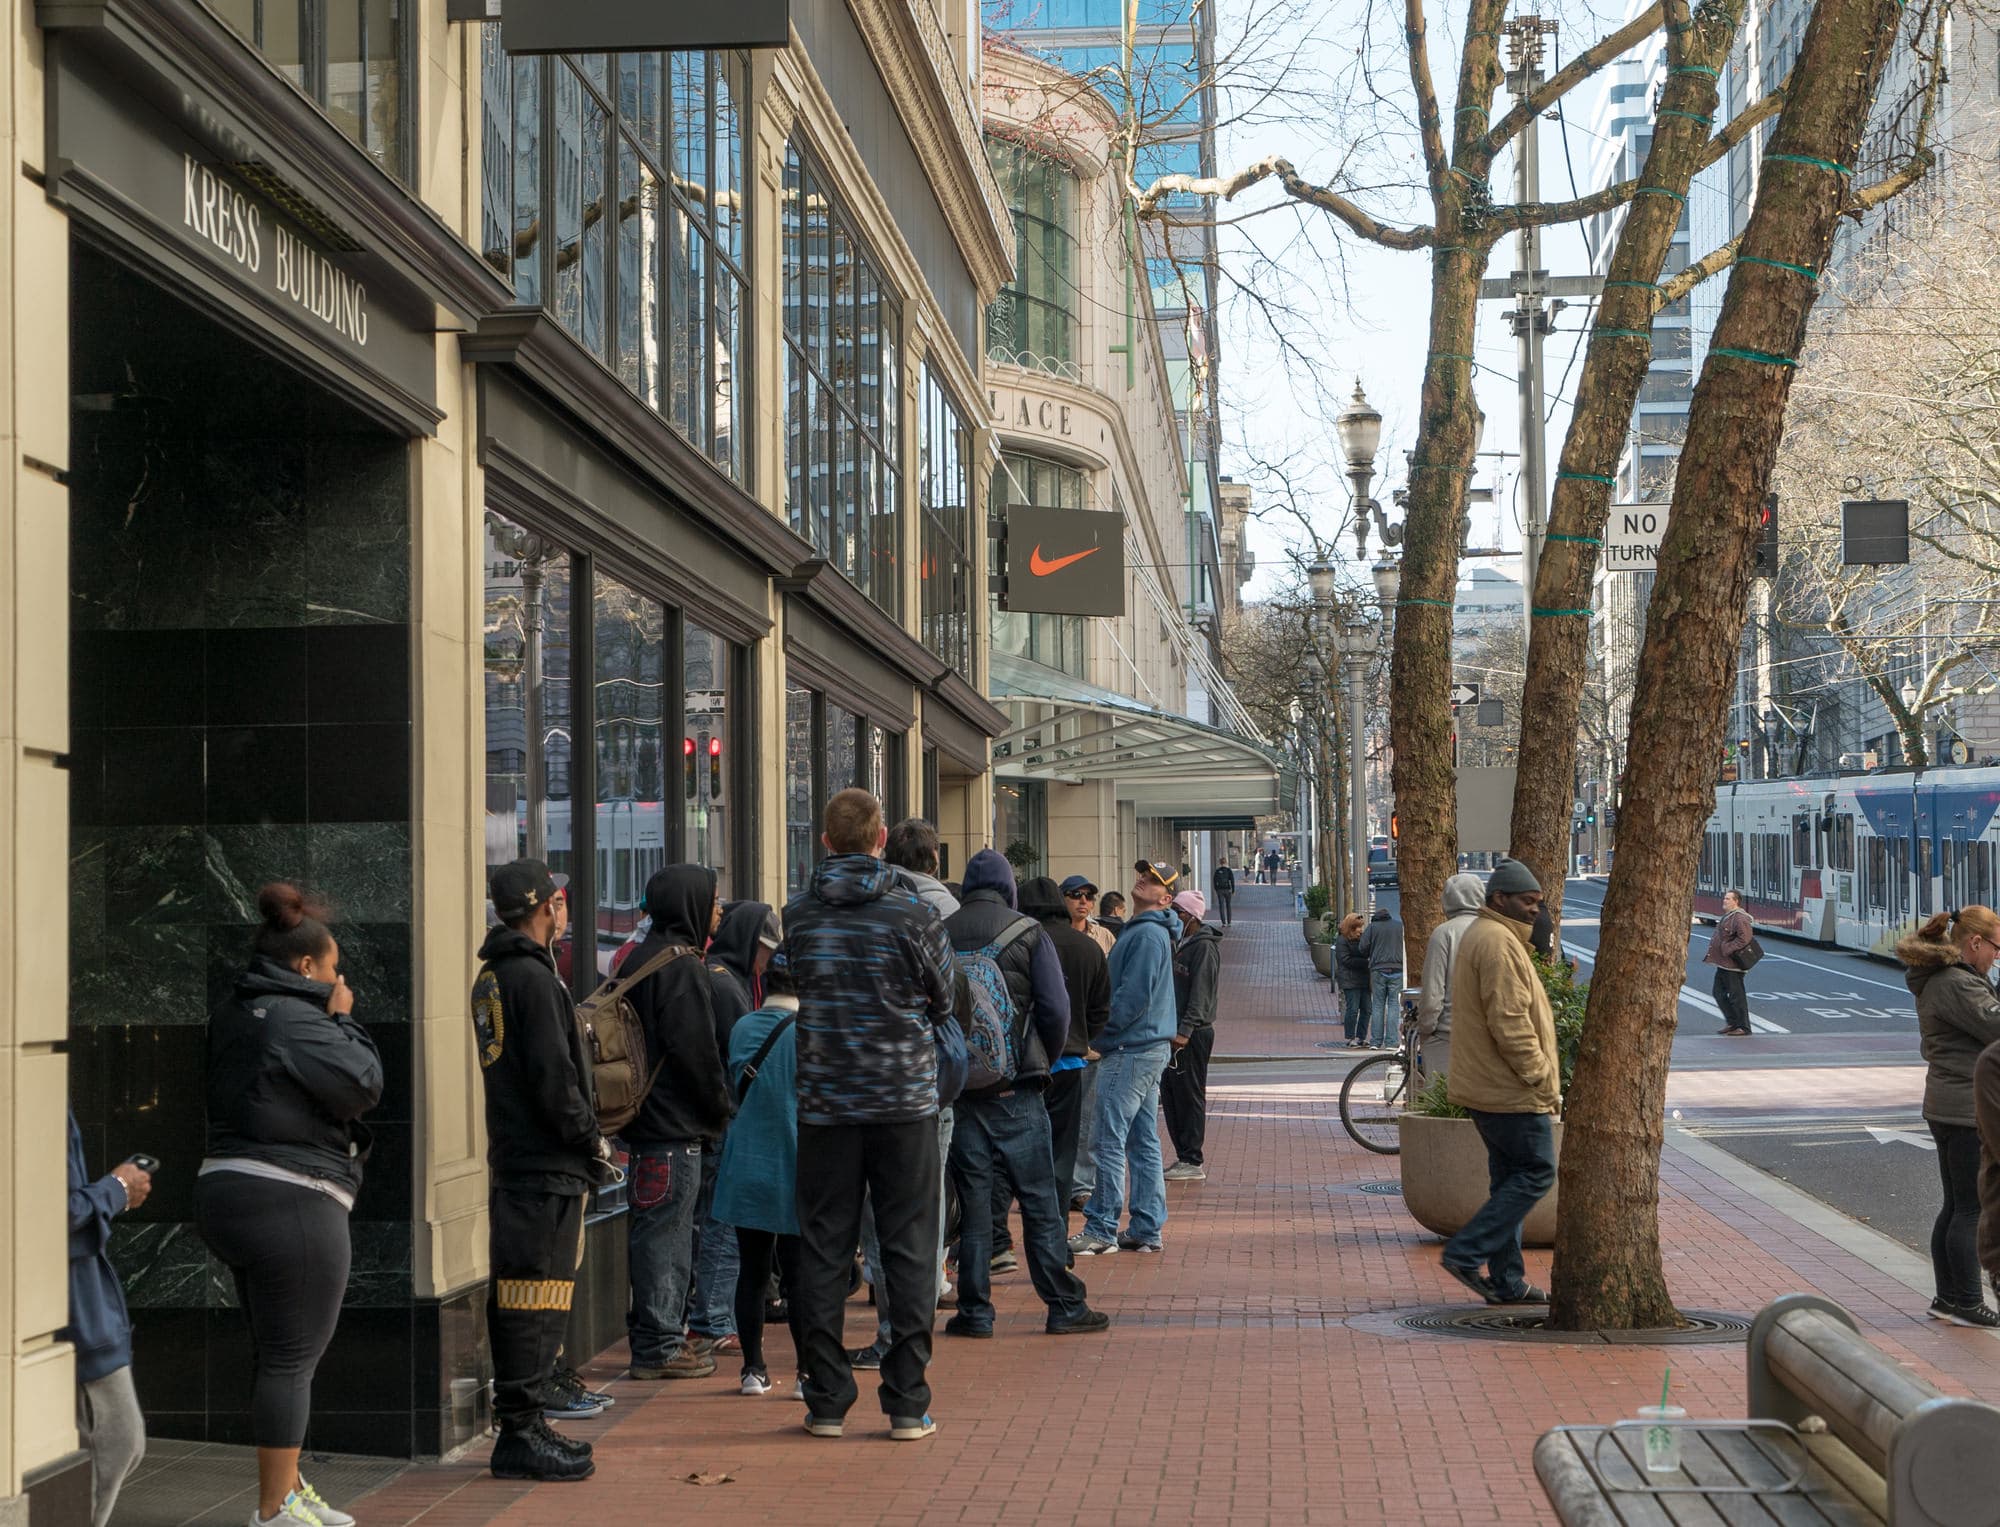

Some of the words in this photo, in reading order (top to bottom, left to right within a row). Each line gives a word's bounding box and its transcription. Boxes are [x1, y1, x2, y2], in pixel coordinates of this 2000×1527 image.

[184, 153, 260, 273] KRESS
[276, 224, 367, 346] BUILDING
[1624, 513, 1657, 534] NO
[1746, 992, 1867, 1000] ONLY
[1803, 1007, 1918, 1018] BUS
